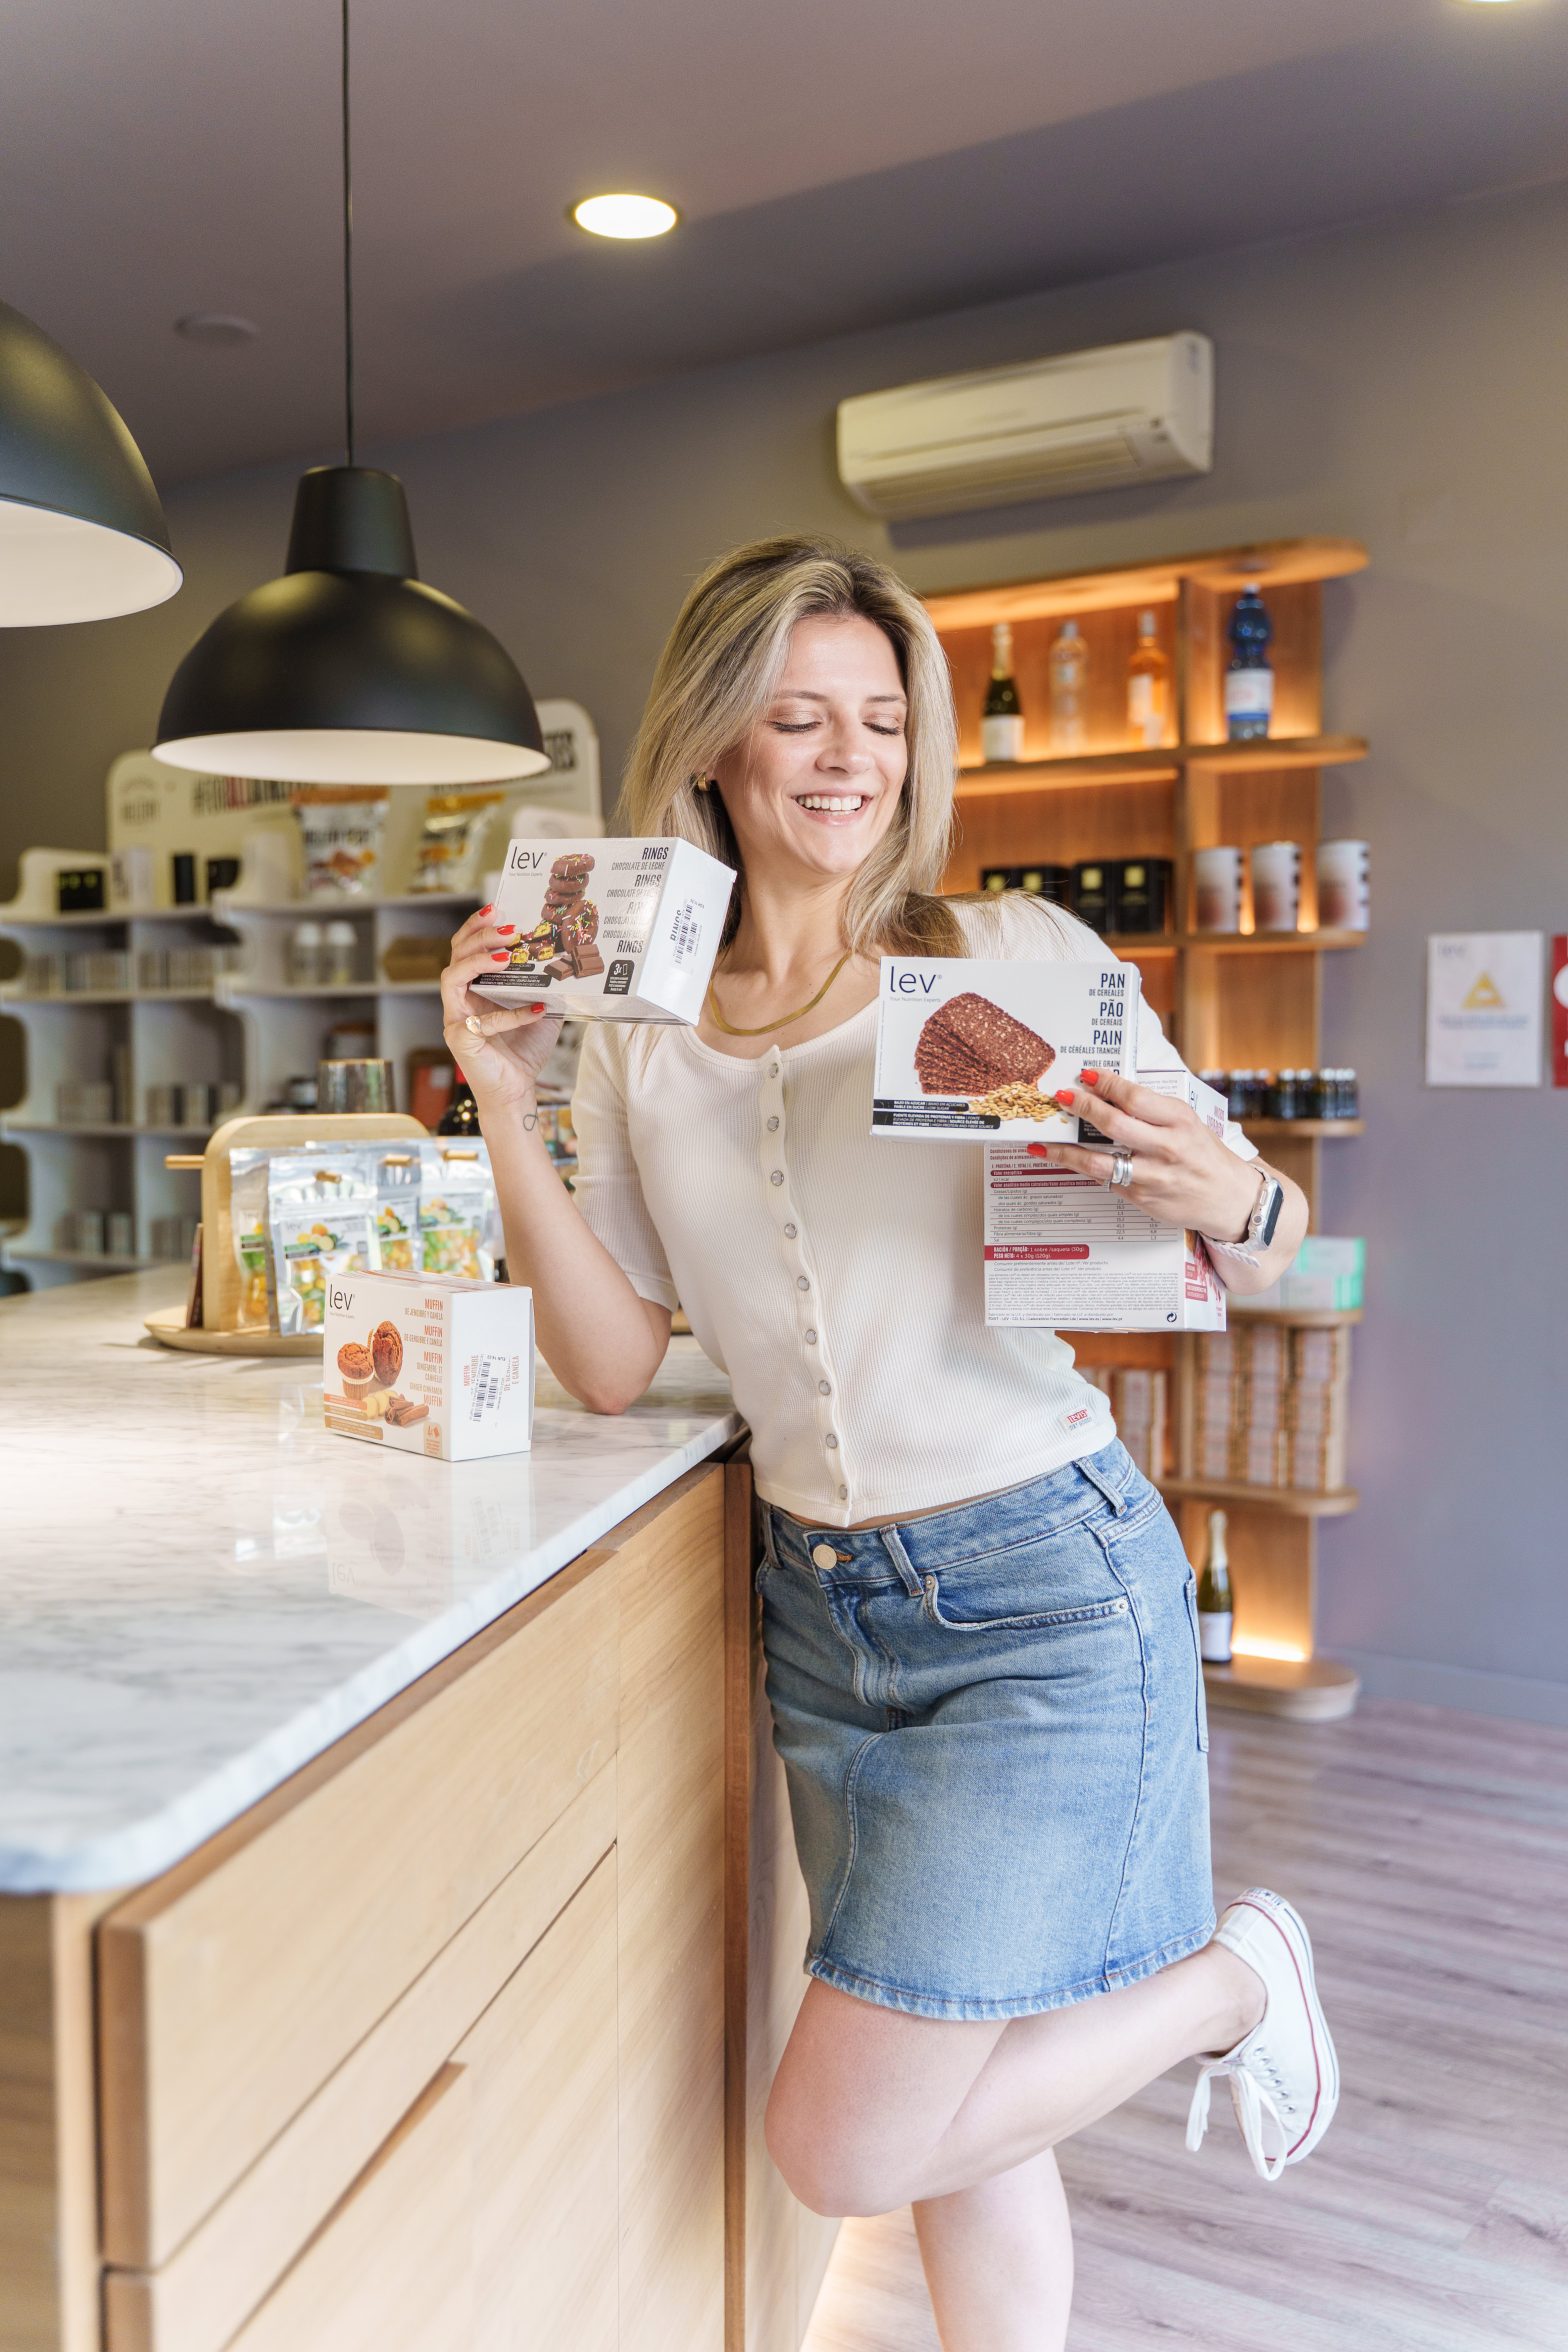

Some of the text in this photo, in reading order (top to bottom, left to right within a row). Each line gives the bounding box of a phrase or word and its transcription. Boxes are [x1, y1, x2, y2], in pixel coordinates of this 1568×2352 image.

[642, 847, 669, 860] RINGS
[611, 862, 665, 871] CHOCOLATE DE LECHE
[634, 874, 662, 888] RINGS
[616, 940, 644, 953] RINGS
[1101, 973, 1125, 988] PAN
[1088, 989, 1124, 997] DE CEREALES
[1100, 998, 1124, 1017] PÃO
[1091, 1018, 1123, 1026] DE CEREAIS
[1093, 1029, 1122, 1045] PAIN
[1068, 1045, 1095, 1054] CÉRÉALES
[1096, 1046, 1121, 1055] TRANCHÉ
[424, 1298, 443, 1311] MUFFIN
[424, 1325, 443, 1338] MUFFIN
[424, 1351, 443, 1364] MUFFIN
[424, 1394, 443, 1407] MUFFIN
